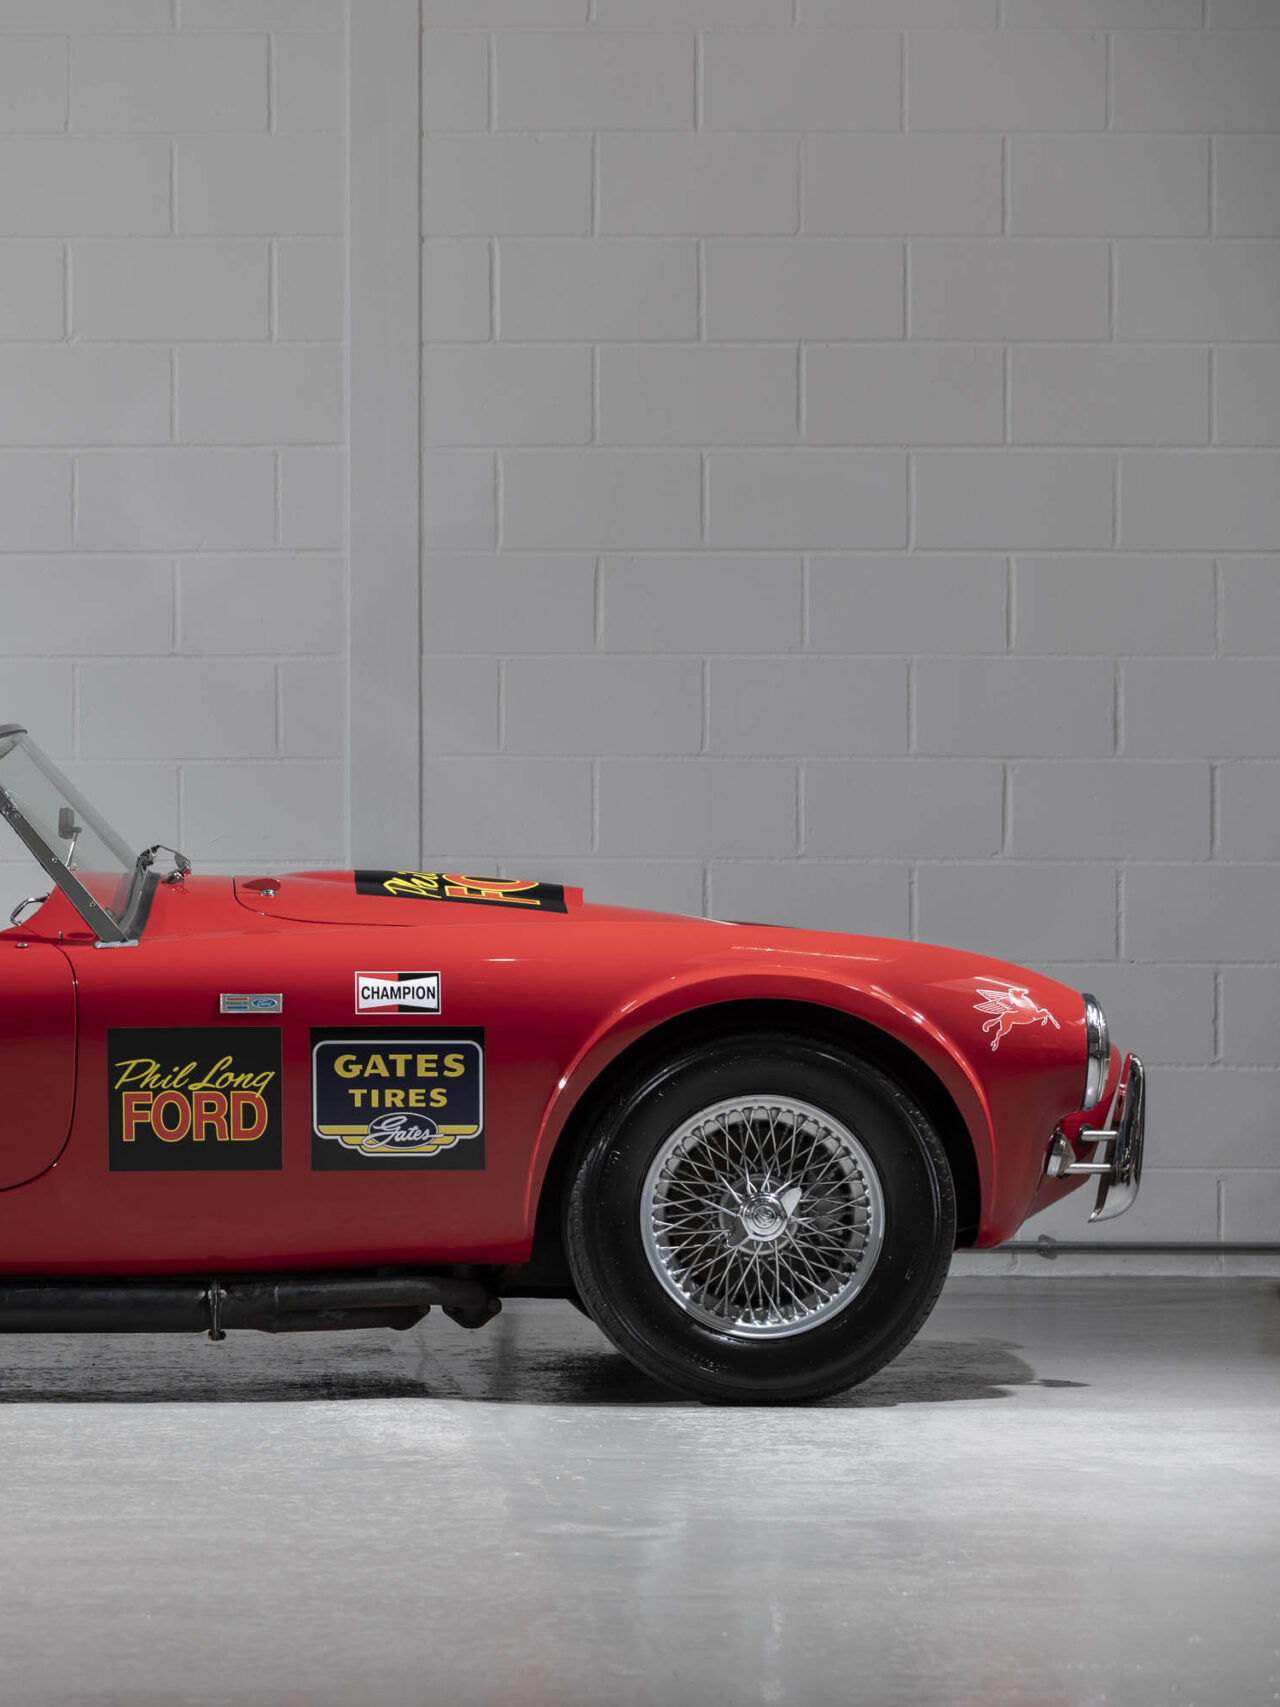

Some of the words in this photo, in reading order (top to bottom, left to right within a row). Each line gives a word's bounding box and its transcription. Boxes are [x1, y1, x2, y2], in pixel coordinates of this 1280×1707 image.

[361, 986, 436, 1000] CHAMPION
[114, 1058, 198, 1090] Phil
[187, 1055, 275, 1098] Long
[333, 1053, 466, 1078] GATES
[348, 1087, 448, 1108] TIRES
[122, 1090, 269, 1142] FORD
[362, 1115, 444, 1149] Gates
